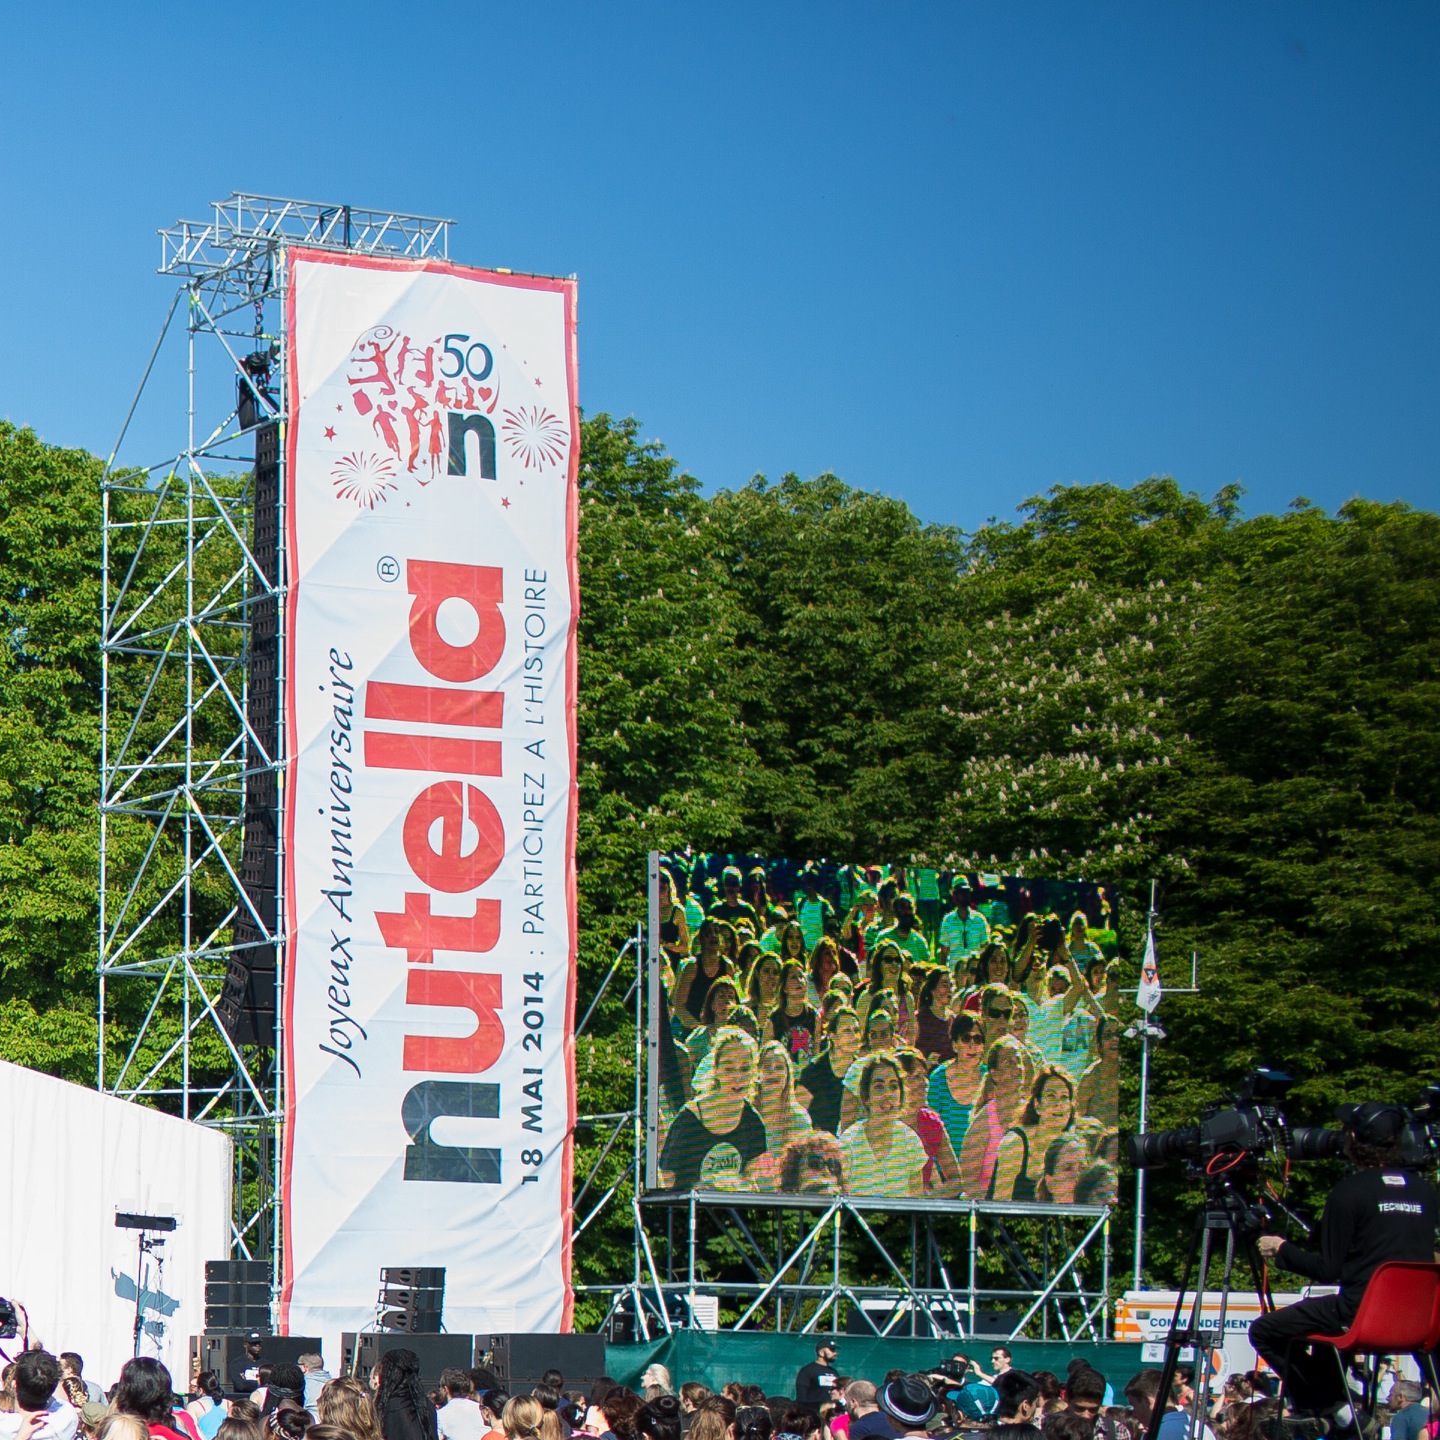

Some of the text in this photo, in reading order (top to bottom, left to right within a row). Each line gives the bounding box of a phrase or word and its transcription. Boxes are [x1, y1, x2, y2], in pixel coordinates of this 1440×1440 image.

[440, 333, 493, 382] 50
[447, 412, 497, 480] n
[523, 568, 548, 725] L'HISTOIRE
[523, 738, 546, 760] A
[318, 647, 368, 1079] Joyeux Anniversaire
[364, 558, 507, 1184] nutella
[522, 772, 546, 934] PARTICIPEZ
[522, 971, 545, 1052] 2014
[521, 1067, 544, 1133] MAI
[520, 1148, 543, 1185] 18
